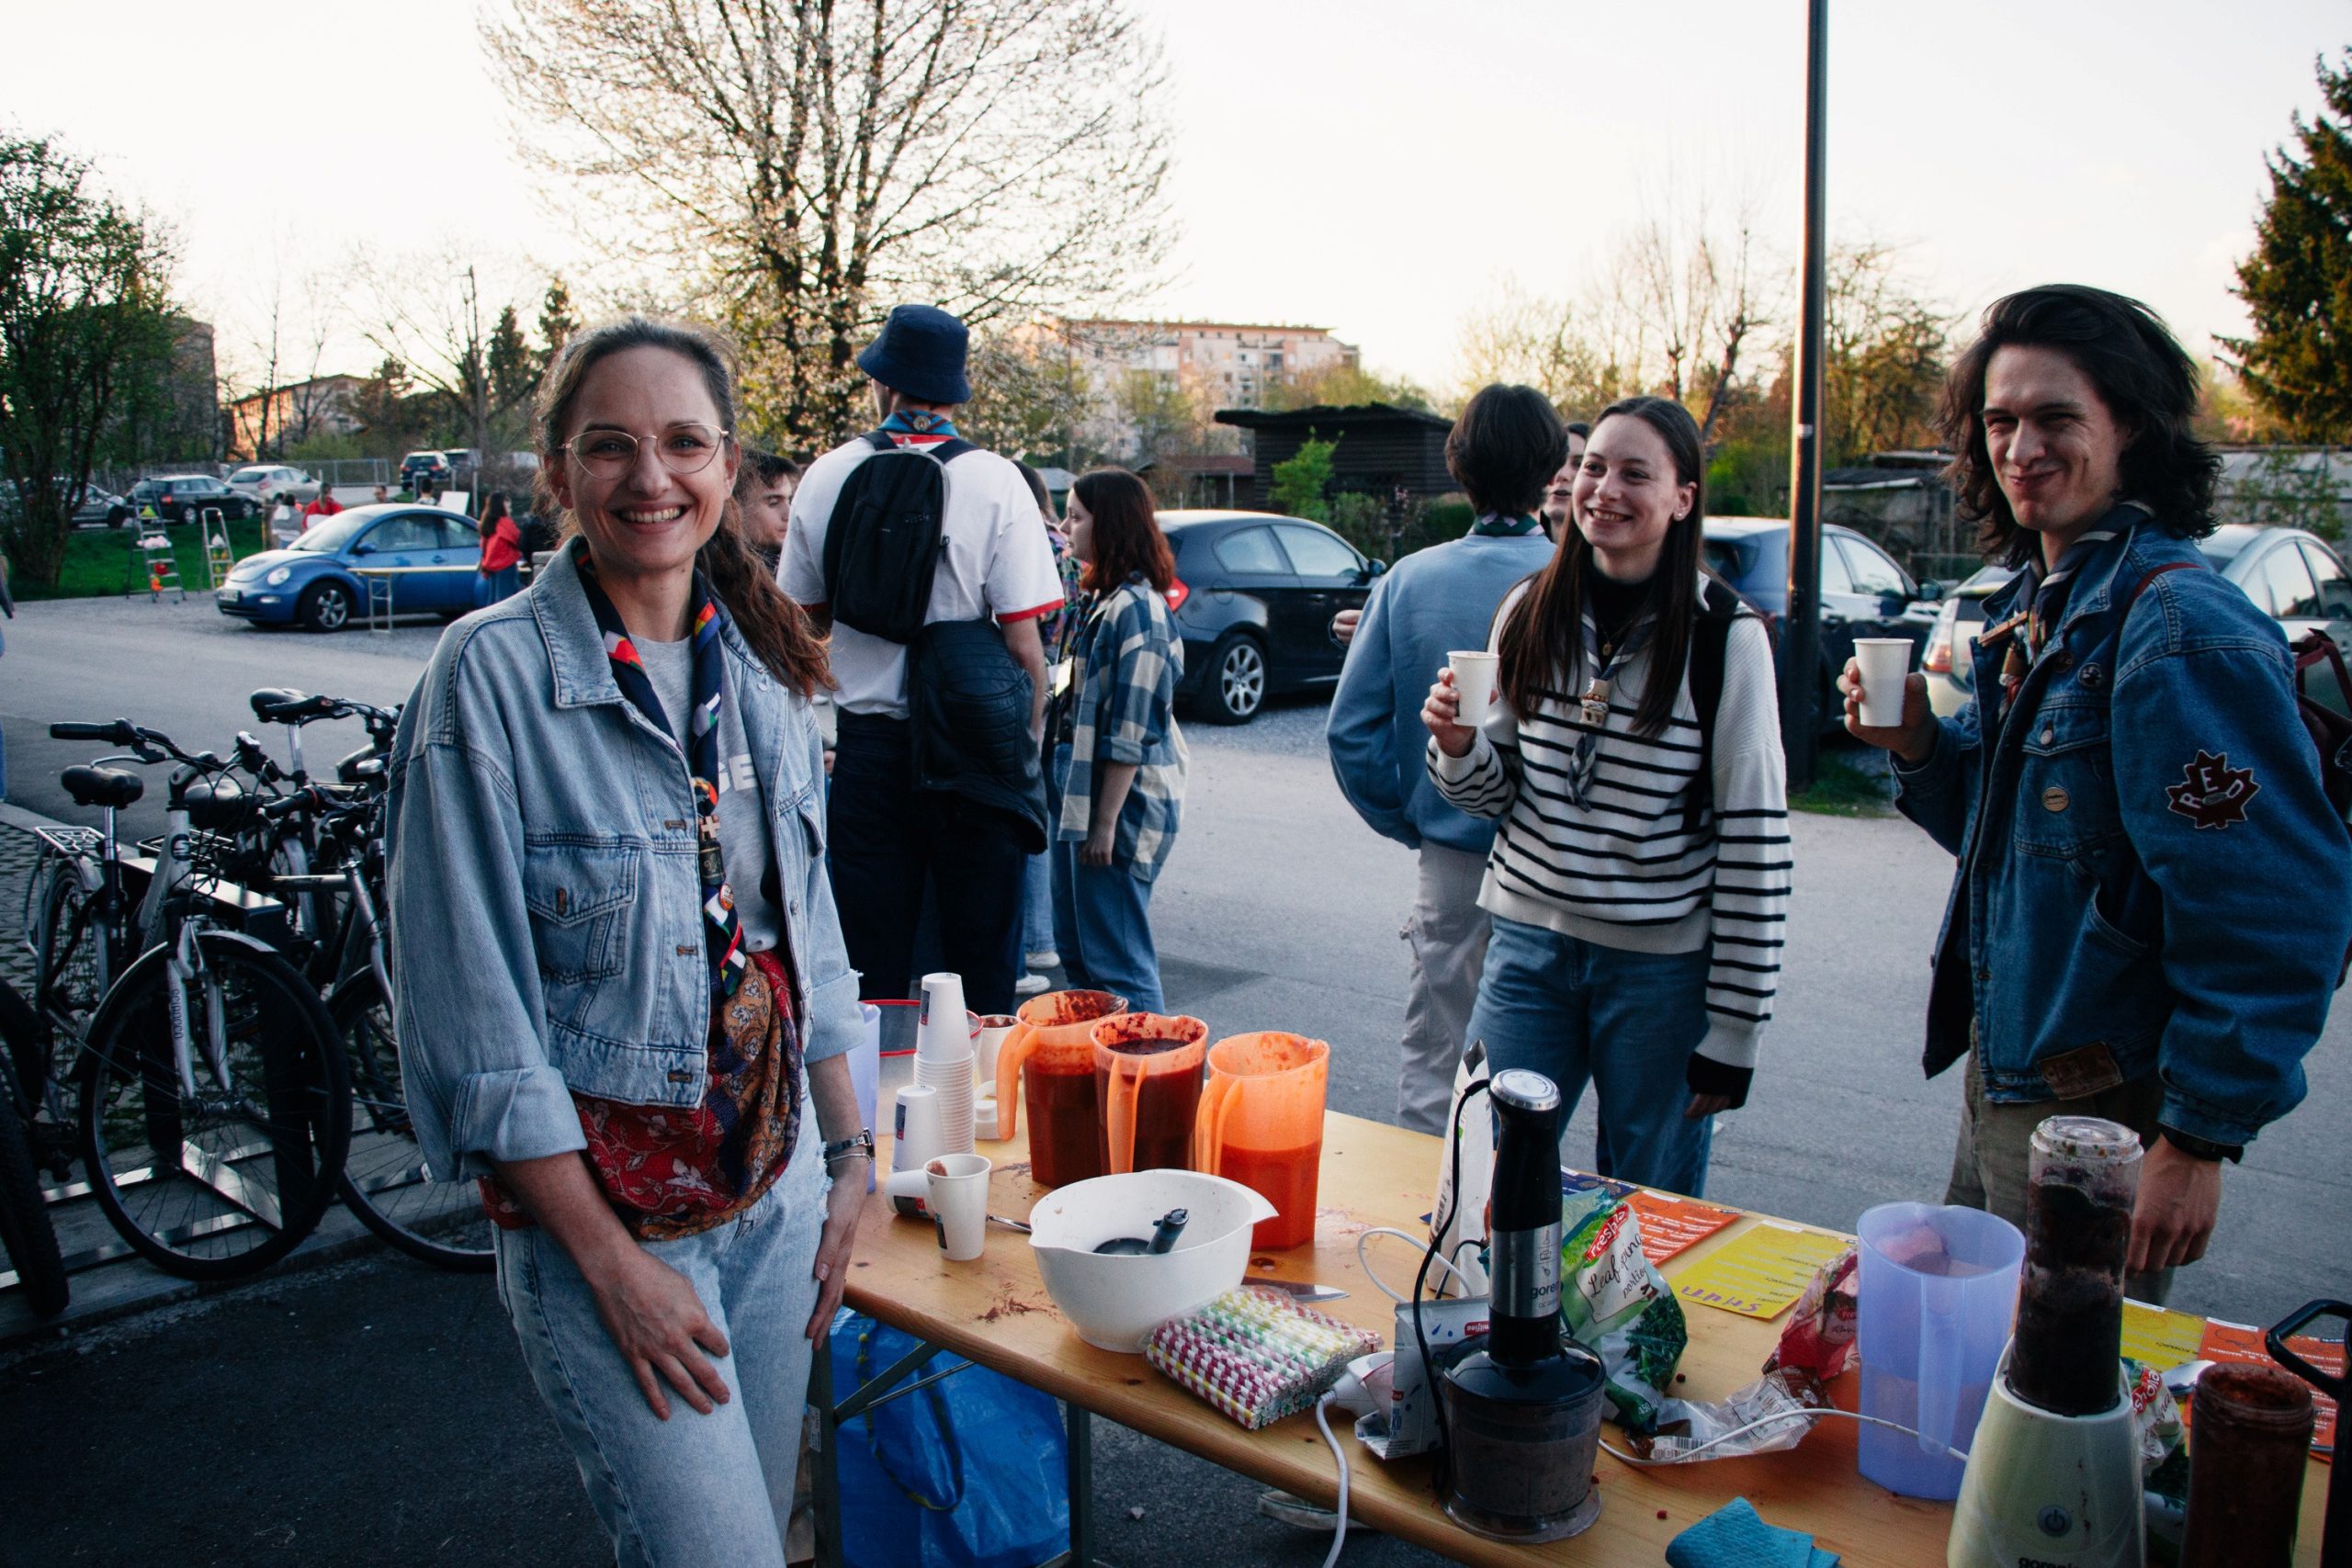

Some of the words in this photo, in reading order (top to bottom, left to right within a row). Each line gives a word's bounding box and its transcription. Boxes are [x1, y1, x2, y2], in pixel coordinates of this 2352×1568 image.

[2178, 766, 2245, 809] RED
[1588, 1255, 1621, 1299] Leaf
[1623, 1267, 1647, 1299] portio
